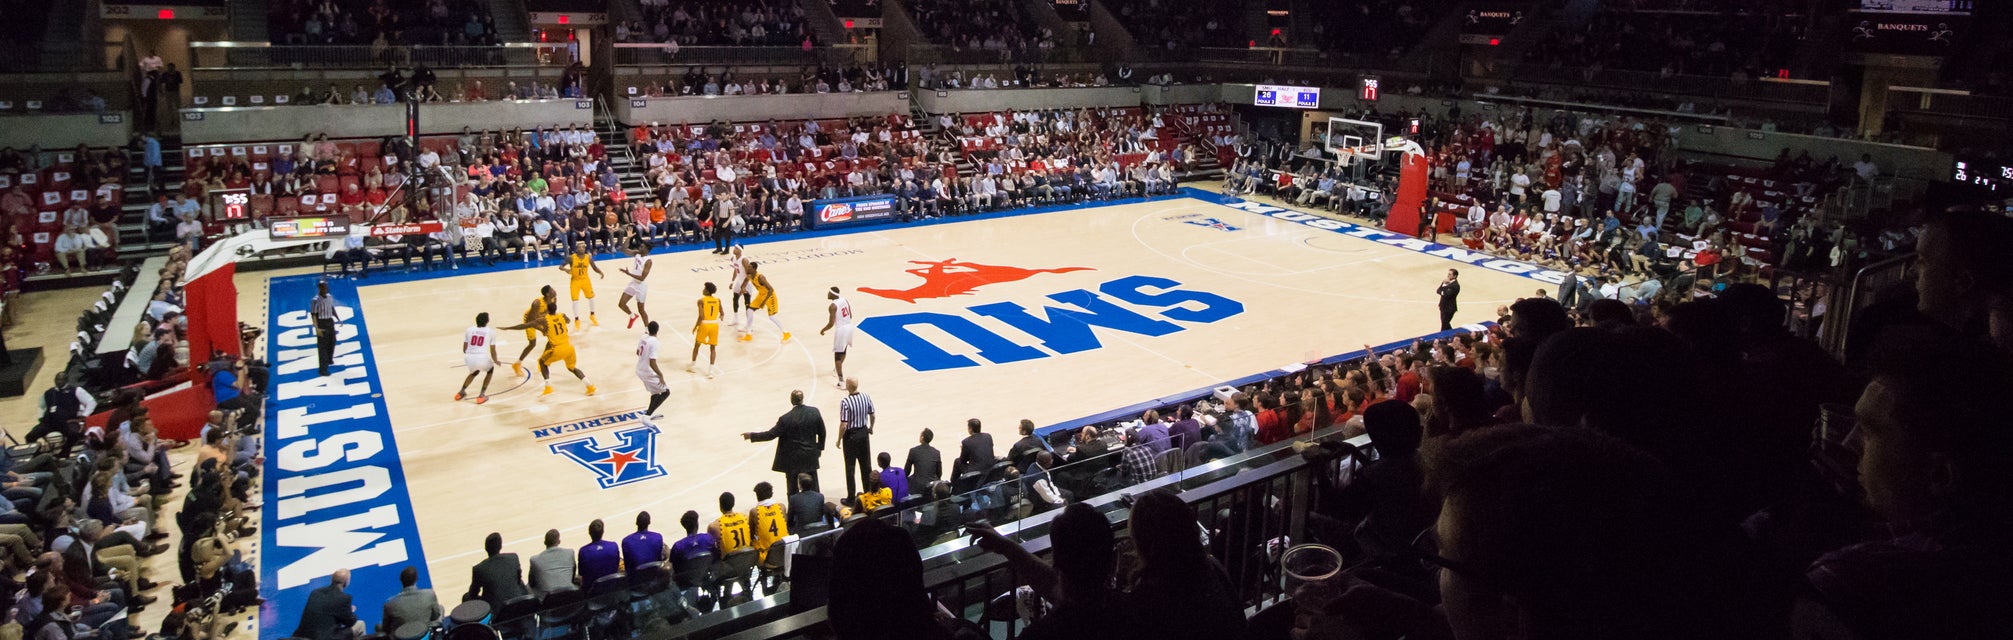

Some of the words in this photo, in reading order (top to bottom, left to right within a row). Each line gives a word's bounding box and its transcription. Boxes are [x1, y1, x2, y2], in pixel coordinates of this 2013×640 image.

[1877, 23, 1928, 32] BANQUETS
[1303, 93, 1311, 101] 11
[1364, 87, 1376, 99] 17
[185, 112, 202, 120] 103
[1955, 169, 1967, 181] 26
[222, 193, 248, 204] 7:55
[227, 204, 242, 218] 17
[821, 203, 853, 222] Cane's
[1227, 201, 1588, 285] MUSTANGS
[710, 304, 715, 317] 1
[841, 306, 850, 318] 21
[553, 323, 564, 336] 13
[856, 275, 1245, 373] SMU
[470, 335, 485, 347] 00
[276, 305, 409, 592] MUSTANGS
[769, 518, 779, 537] 4
[730, 528, 745, 549] 31
